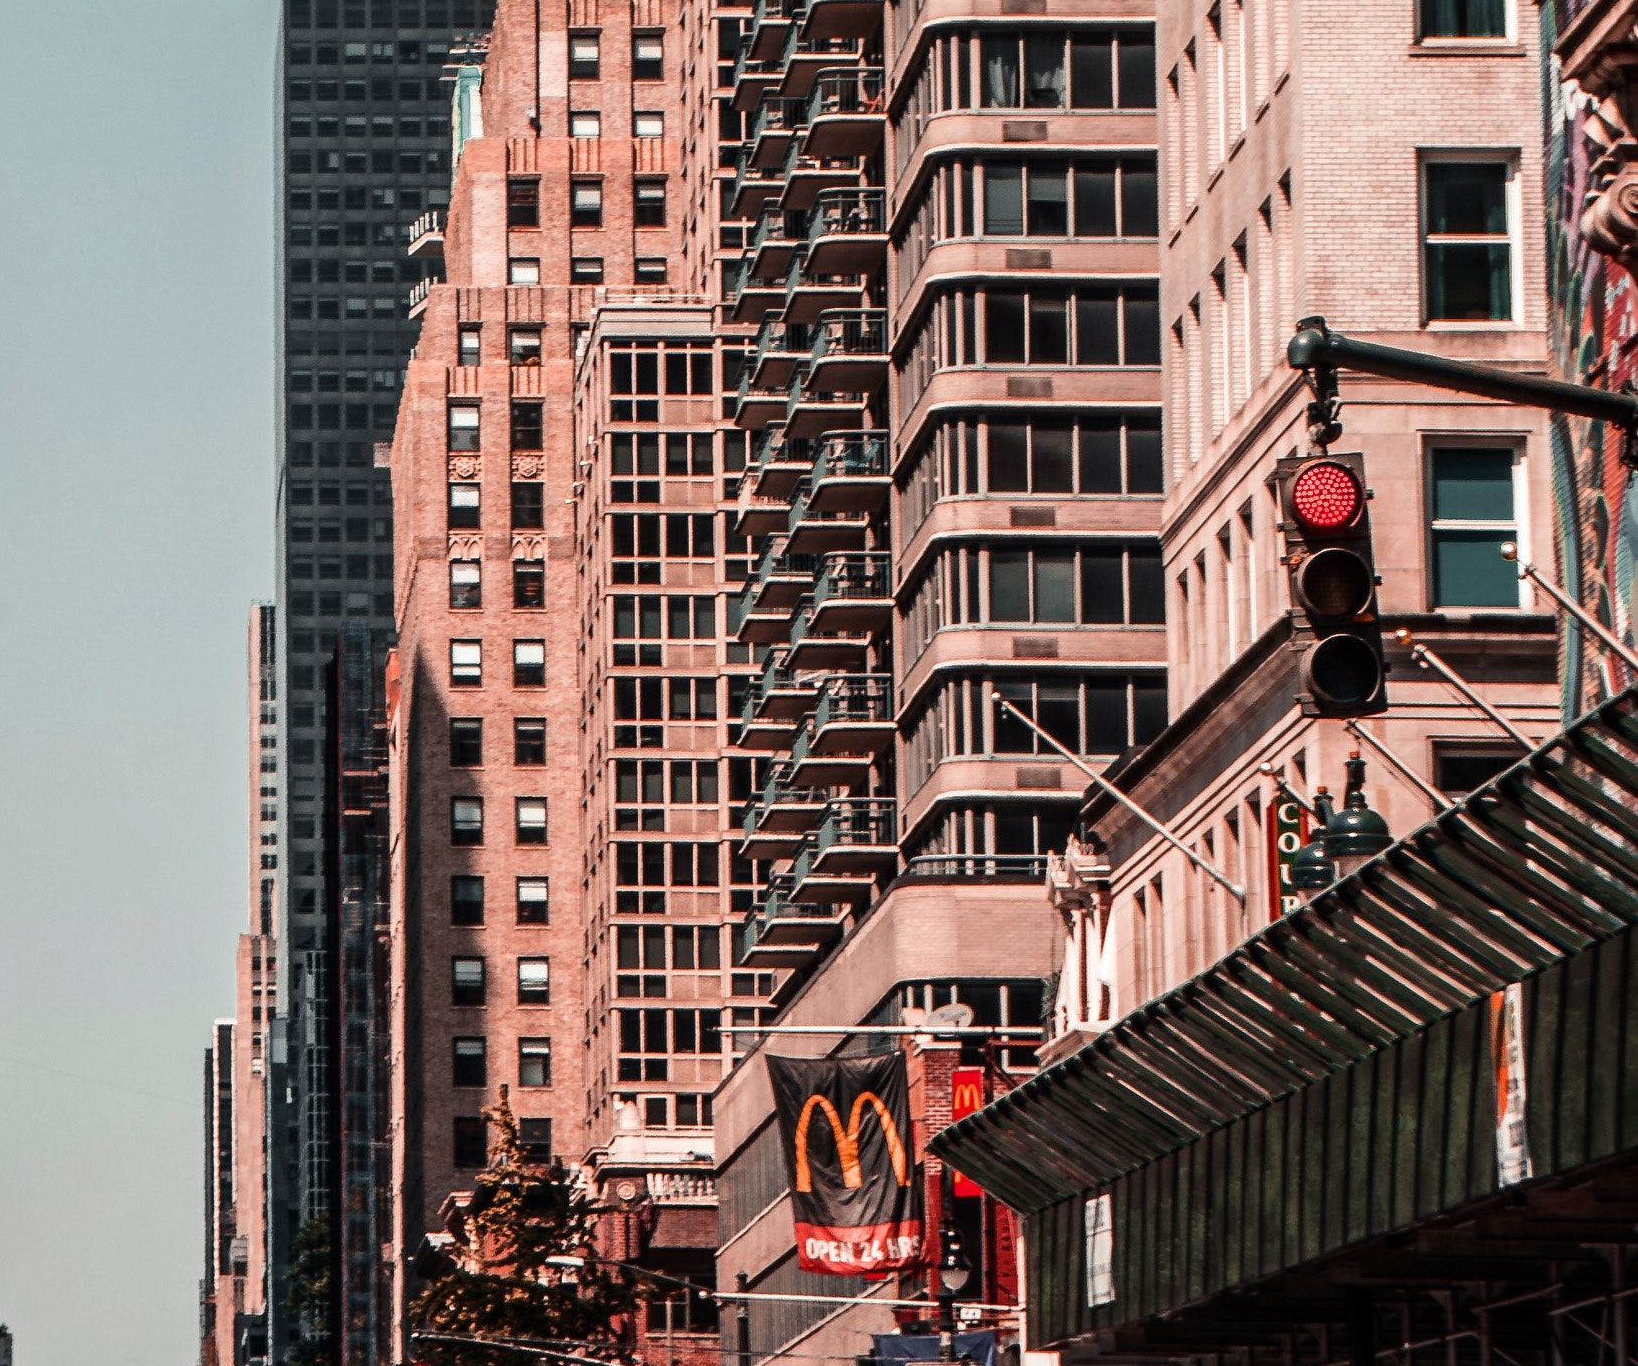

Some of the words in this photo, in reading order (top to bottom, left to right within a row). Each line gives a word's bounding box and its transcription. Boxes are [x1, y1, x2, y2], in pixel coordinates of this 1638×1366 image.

[805, 1238, 856, 1263] OPEN
[861, 1239, 884, 1261] 24
[887, 1235, 921, 1258] HRS
